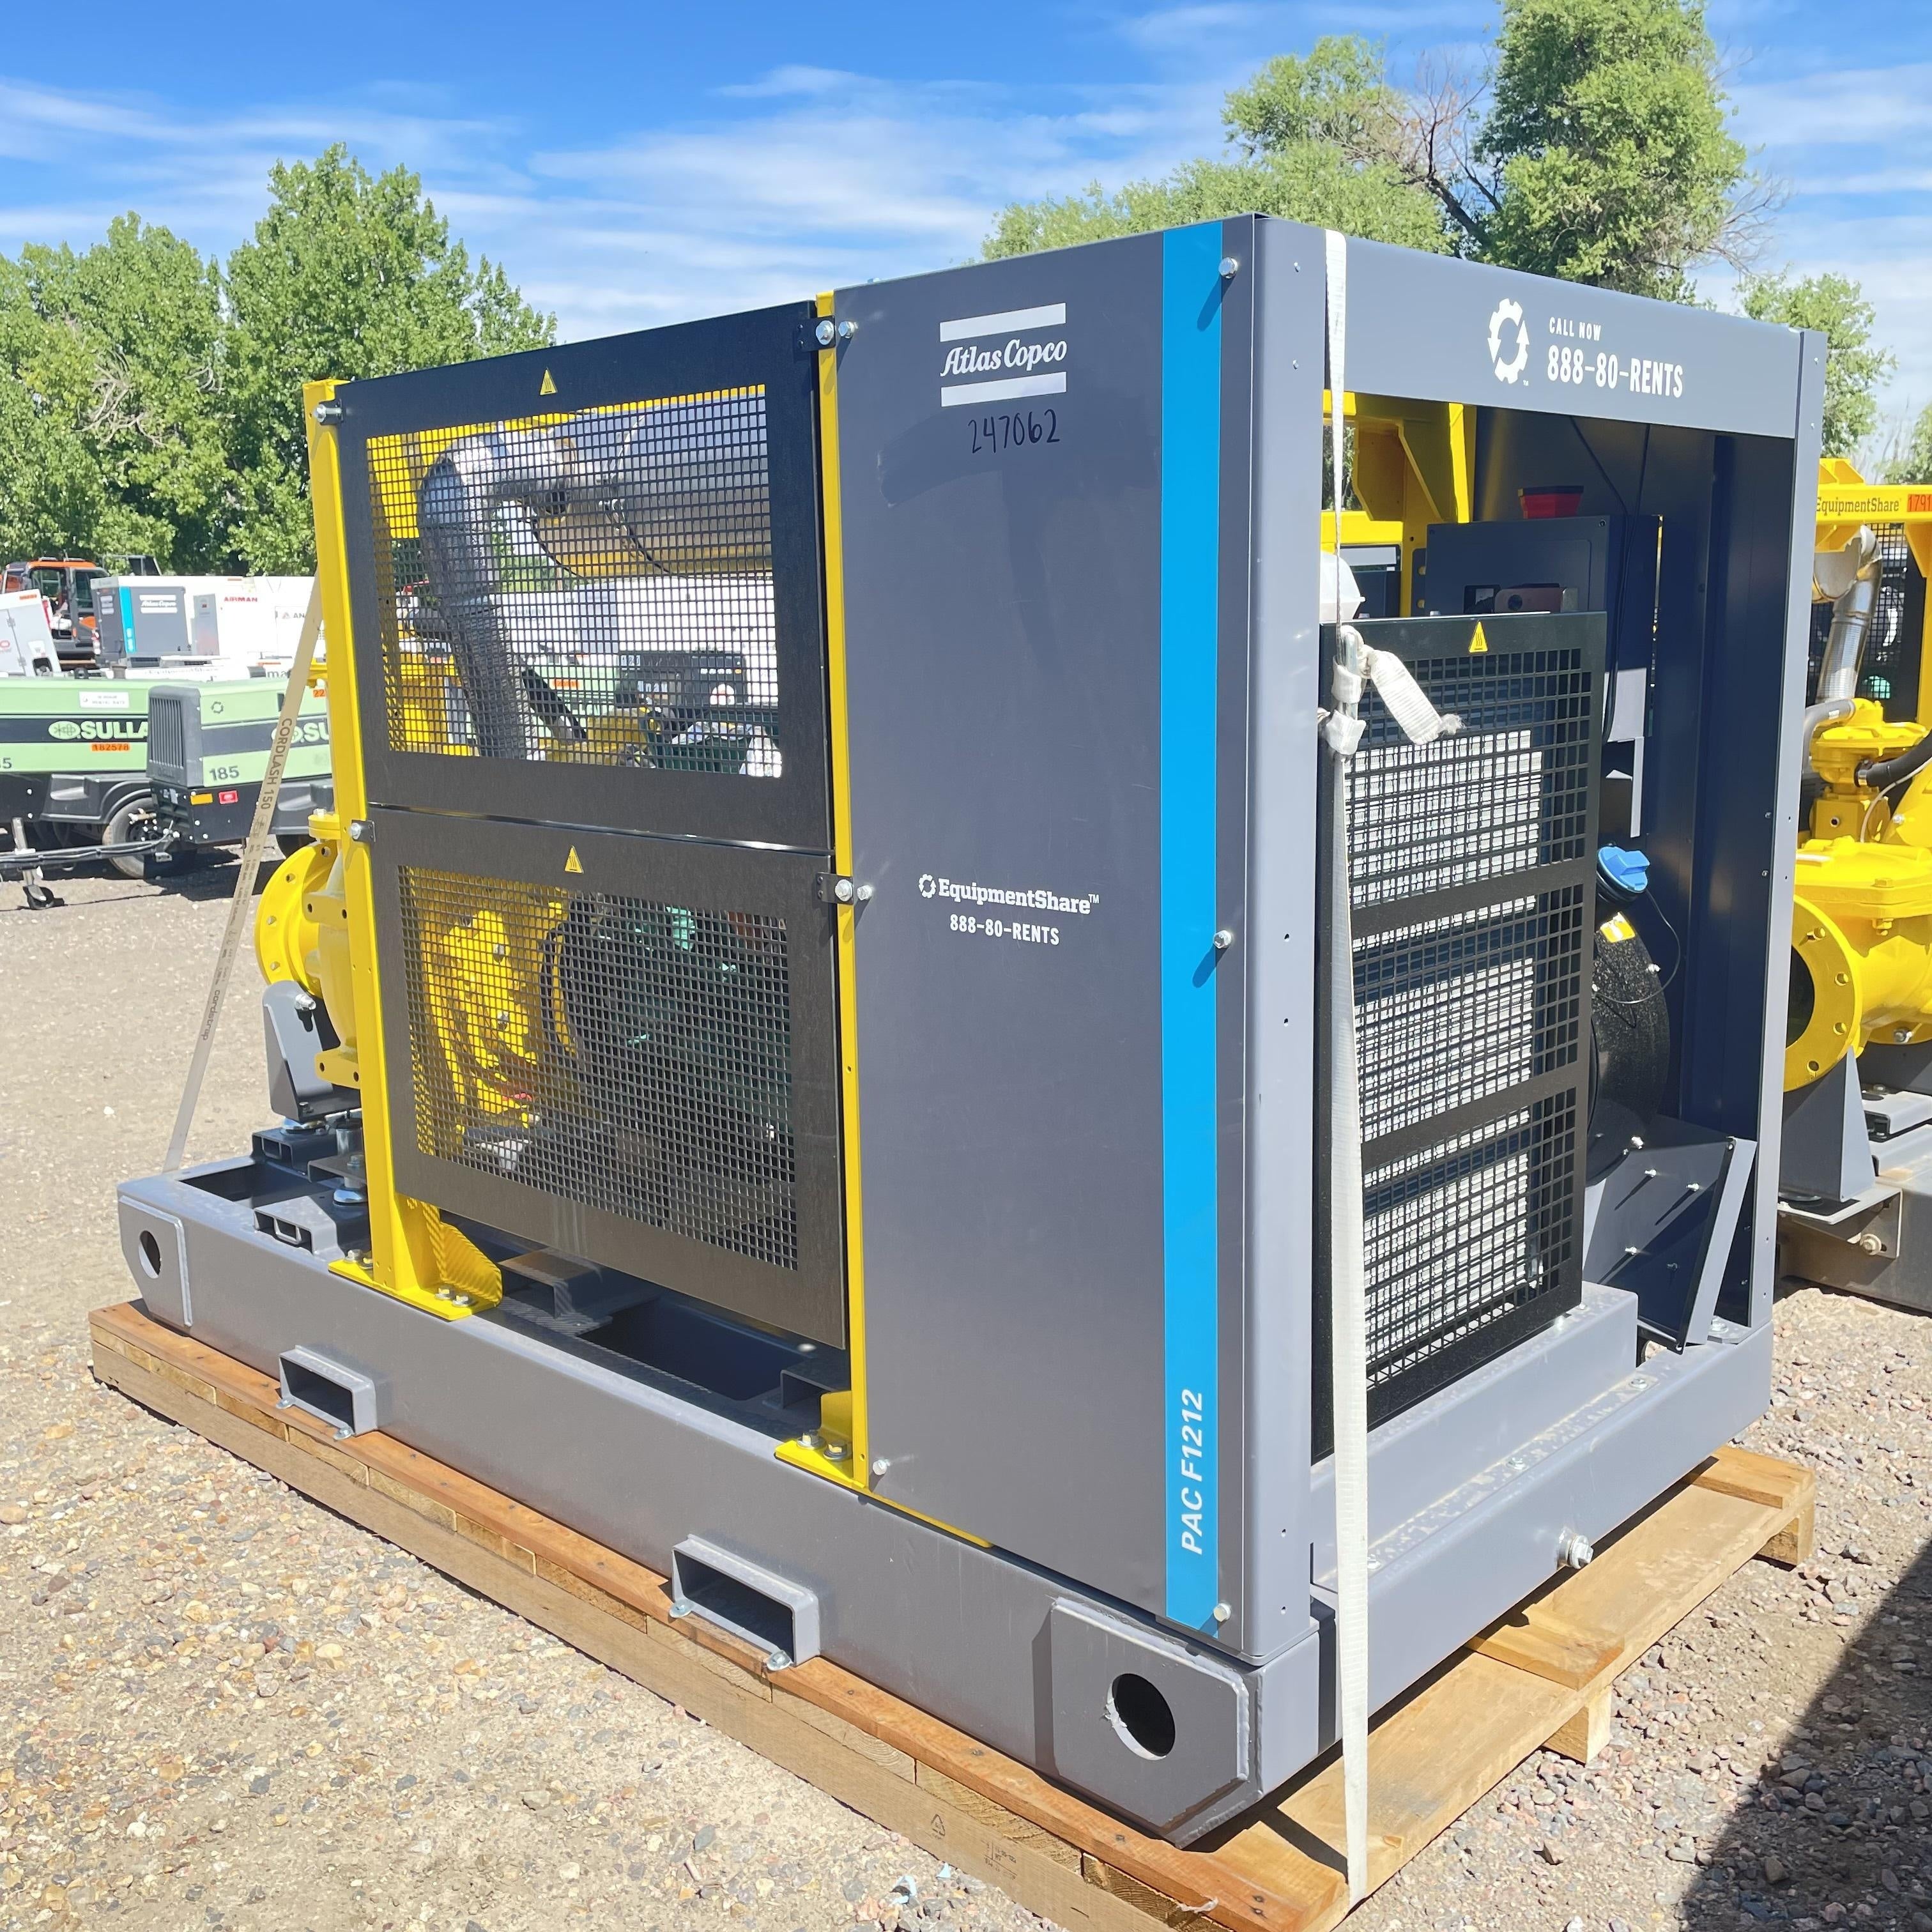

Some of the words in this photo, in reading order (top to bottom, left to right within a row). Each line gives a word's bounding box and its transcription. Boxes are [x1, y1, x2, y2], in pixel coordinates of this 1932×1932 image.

[1549, 317, 1574, 337] CALL
[1579, 321, 1602, 341] NOW
[940, 345, 1002, 378] Atlas
[1004, 339, 1068, 371] Copco
[1547, 344, 1684, 399] 888-80-RENTS
[967, 408, 1061, 454] 247062
[266, 717, 293, 785] CORDLASH
[209, 765, 240, 781] 185
[261, 788, 274, 810] 150
[950, 914, 1060, 946] 888-80-RENTS
[1181, 1389, 1202, 1482] F1212
[1181, 1487, 1202, 1555] PAC
